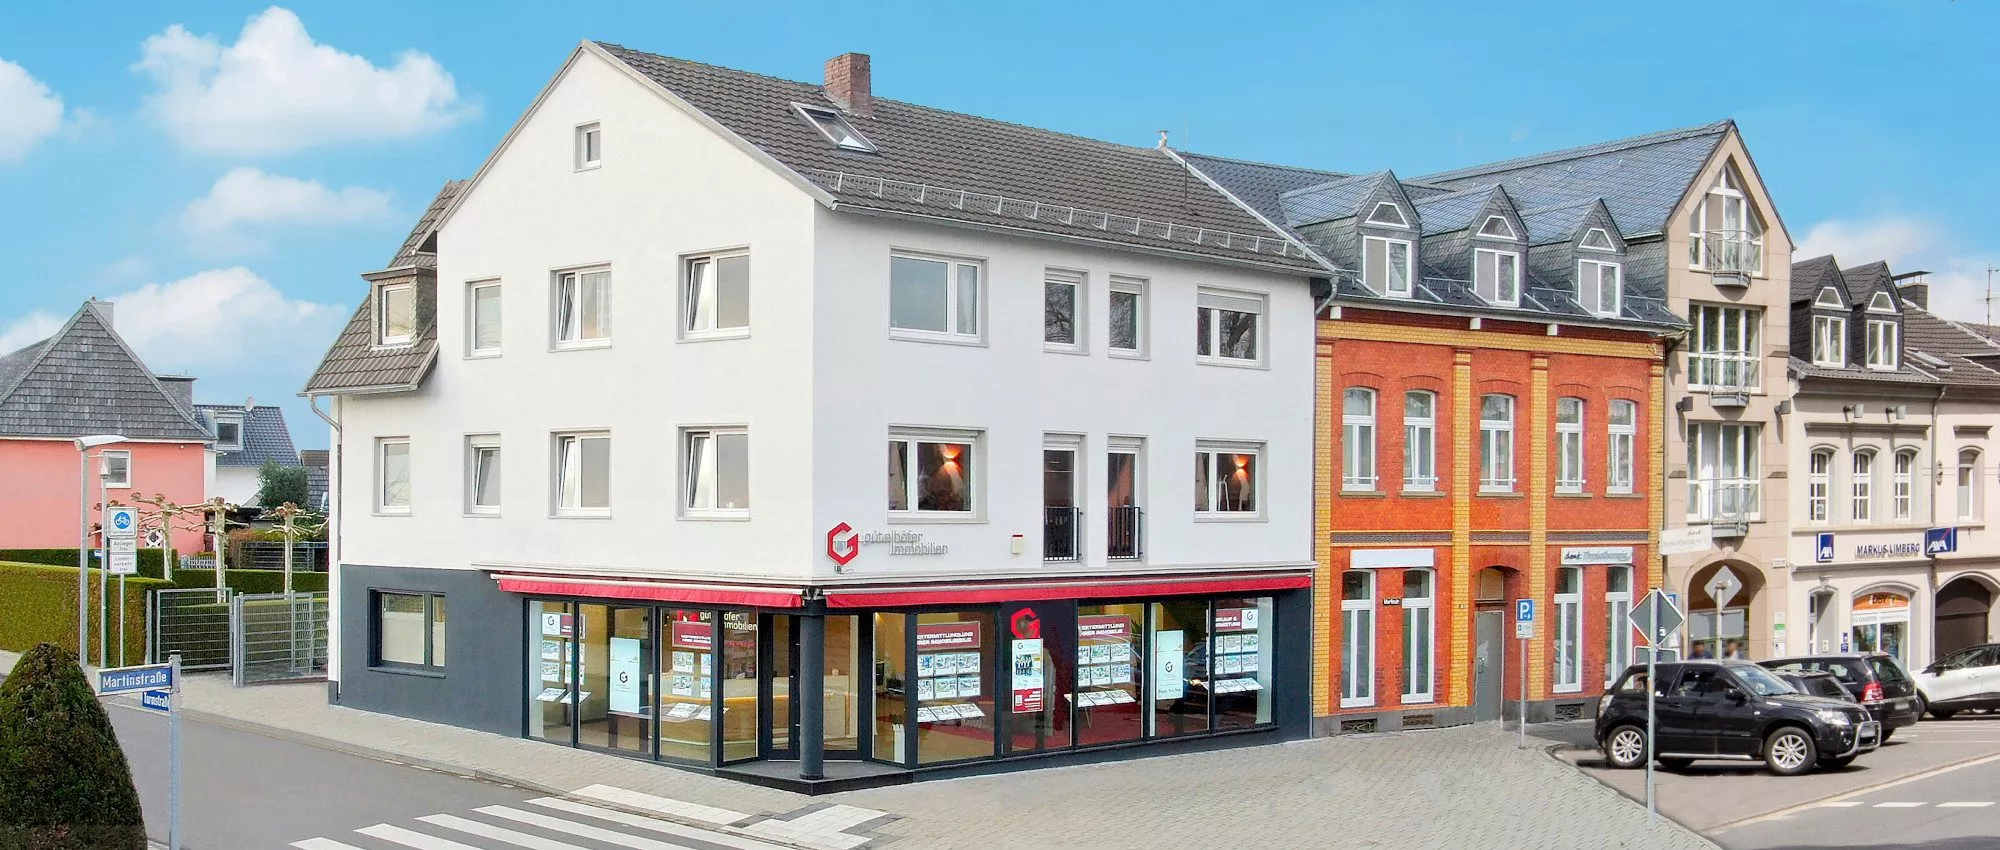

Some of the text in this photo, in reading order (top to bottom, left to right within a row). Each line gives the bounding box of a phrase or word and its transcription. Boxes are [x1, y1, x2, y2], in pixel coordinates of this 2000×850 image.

[1856, 543, 1921, 555] MARKUS LIMBERG
[1926, 540, 1948, 553] AXA
[1520, 602, 1530, 620] P
[723, 621, 758, 632] mobilien
[102, 671, 167, 689] Martinstraße
